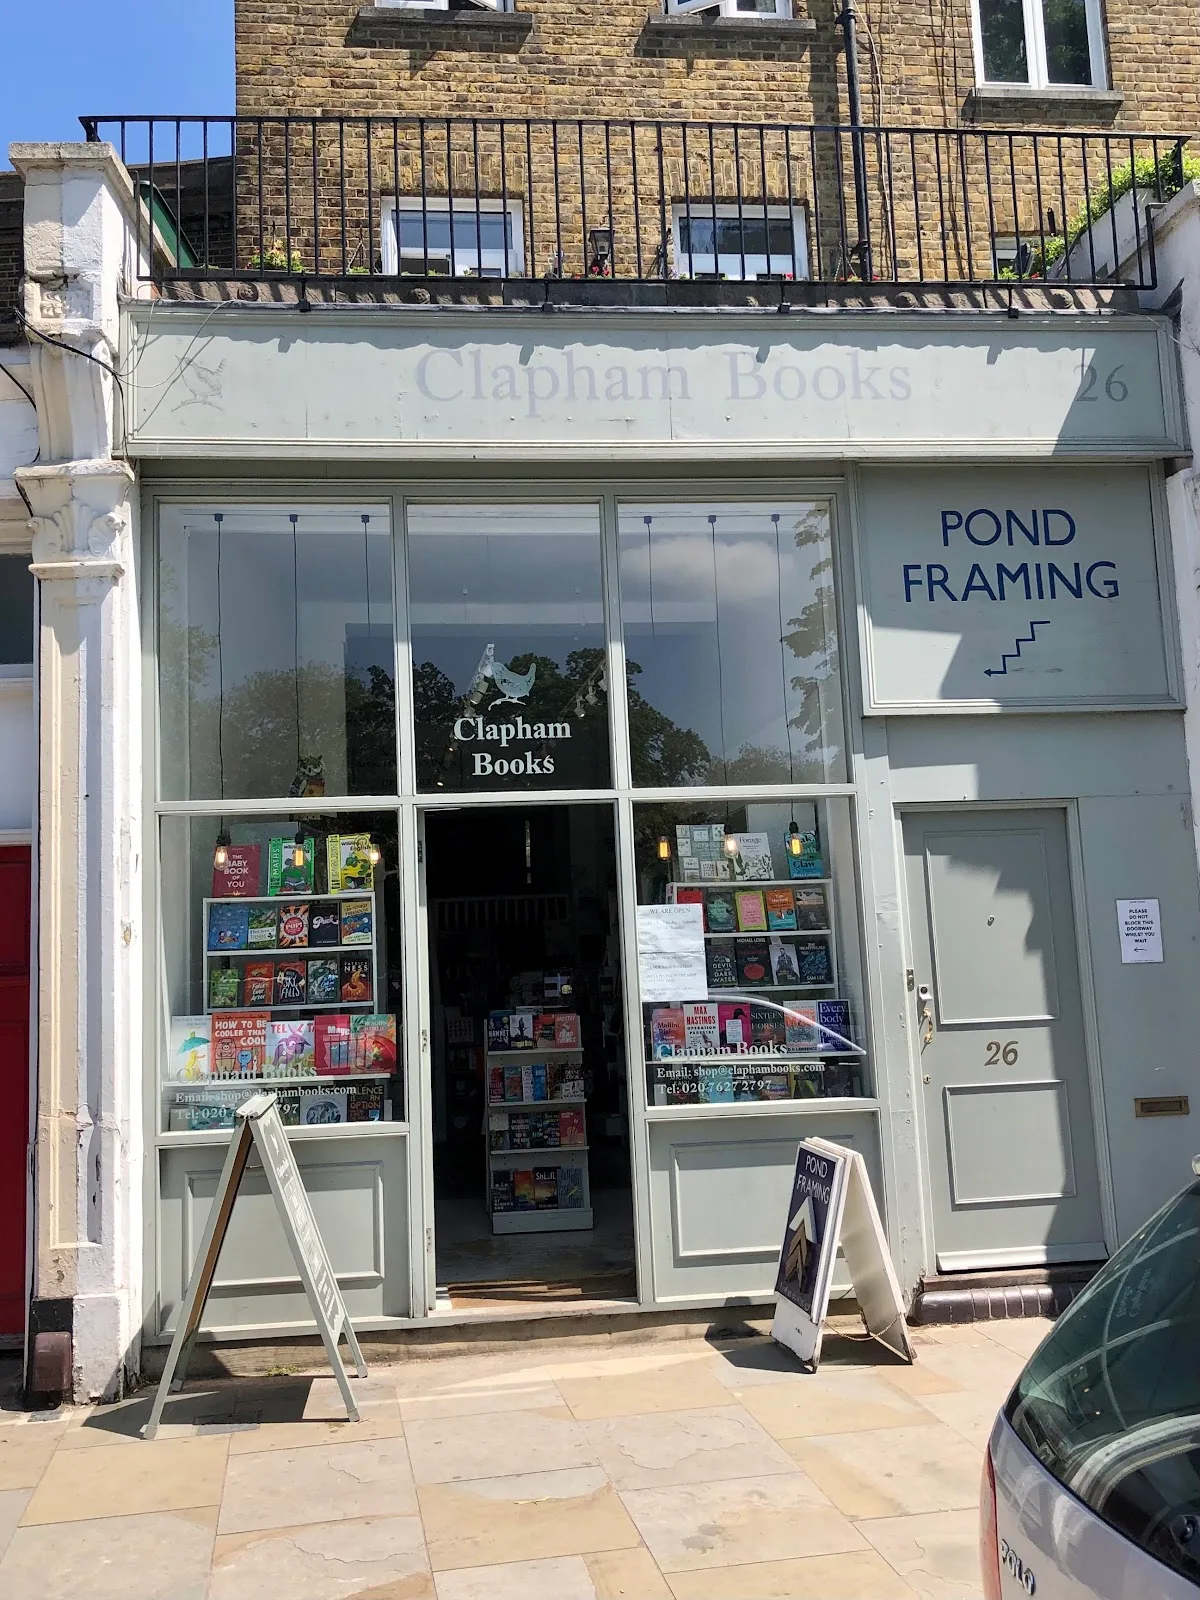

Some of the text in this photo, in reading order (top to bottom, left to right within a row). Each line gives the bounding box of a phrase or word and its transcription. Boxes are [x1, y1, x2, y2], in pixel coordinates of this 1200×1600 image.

[414, 348, 912, 419] Clapham Books
[1073, 362, 1130, 402] 26
[941, 508, 1076, 547] POND
[902, 560, 1120, 603] FRAMING
[453, 716, 572, 747] Clapham
[471, 751, 555, 775] Books
[272, 848, 280, 875] MATHS
[224, 867, 249, 875] BOOK
[344, 965, 368, 973] NESS
[693, 1006, 708, 1014] MAX
[819, 1002, 847, 1013] Every
[686, 1015, 716, 1025] HASTINGS
[750, 1012, 784, 1020] SIXTEEN
[820, 1012, 844, 1025] body
[215, 1019, 267, 1030] HOW TO BE
[240, 1036, 267, 1046] COOL
[655, 1039, 788, 1063] Clapham Books
[983, 1040, 1020, 1067] 26
[262, 1062, 318, 1079] Books
[656, 1066, 692, 1079] Email:
[693, 1063, 825, 1079] shop@claphambooks.com
[658, 1079, 772, 1095] Tel: 020 7627 2797
[175, 1107, 200, 1119] Tel:
[201, 1107, 227, 1119] 020
[350, 1101, 381, 1109] OPTION
[805, 1154, 828, 1178] POND
[796, 1173, 831, 1205] FRAMING
